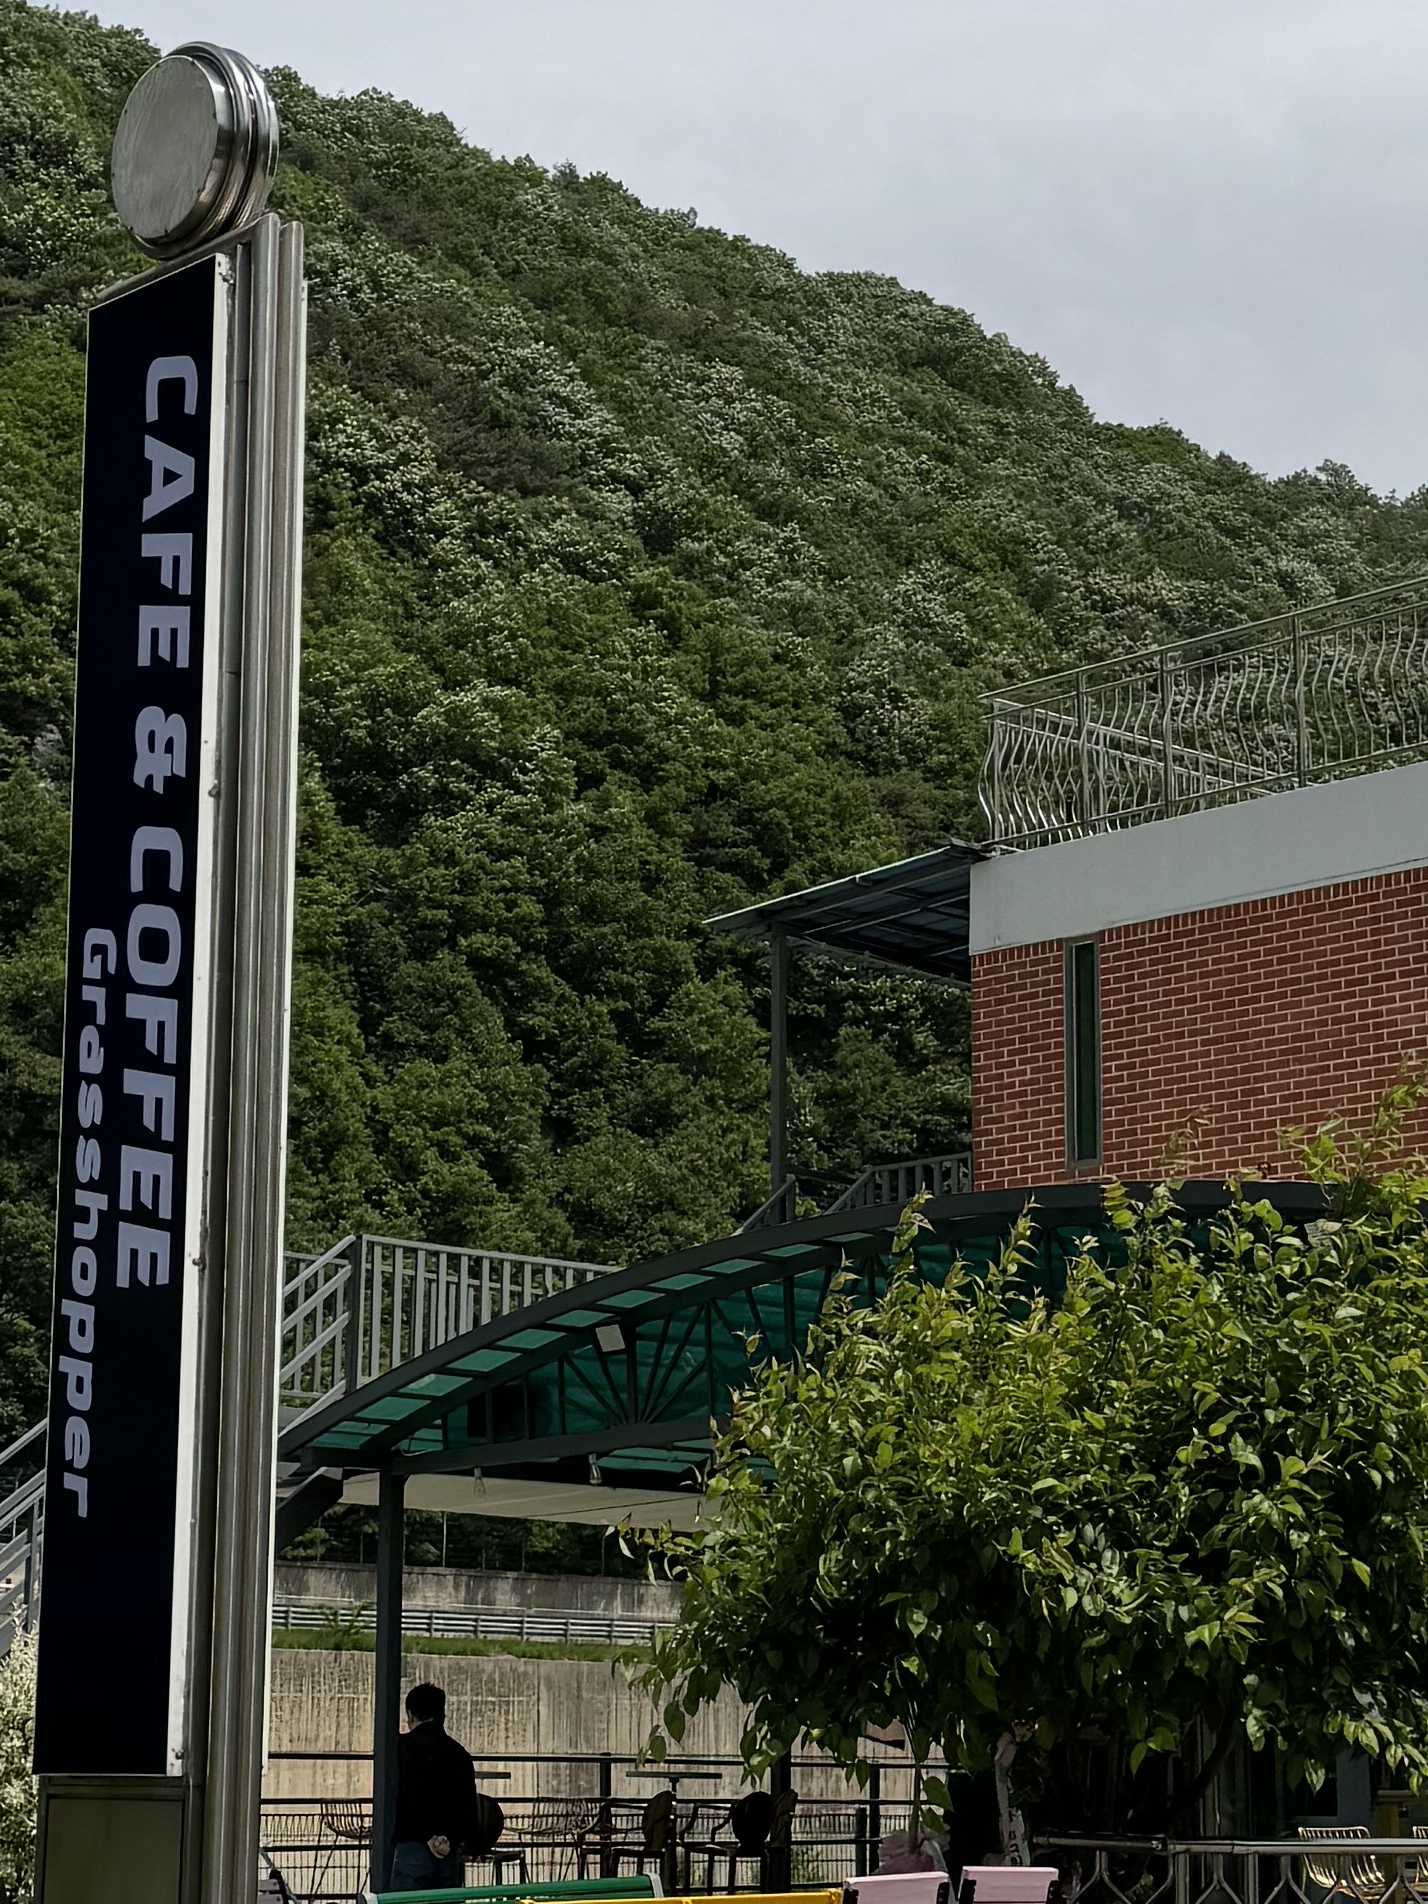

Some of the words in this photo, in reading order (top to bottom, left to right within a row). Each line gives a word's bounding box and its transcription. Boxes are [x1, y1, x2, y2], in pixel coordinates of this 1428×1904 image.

[137, 355, 199, 668] CAFE
[133, 705, 187, 794] &
[58, 927, 118, 1518] Grasshopper
[116, 825, 184, 1289] COFFEE
